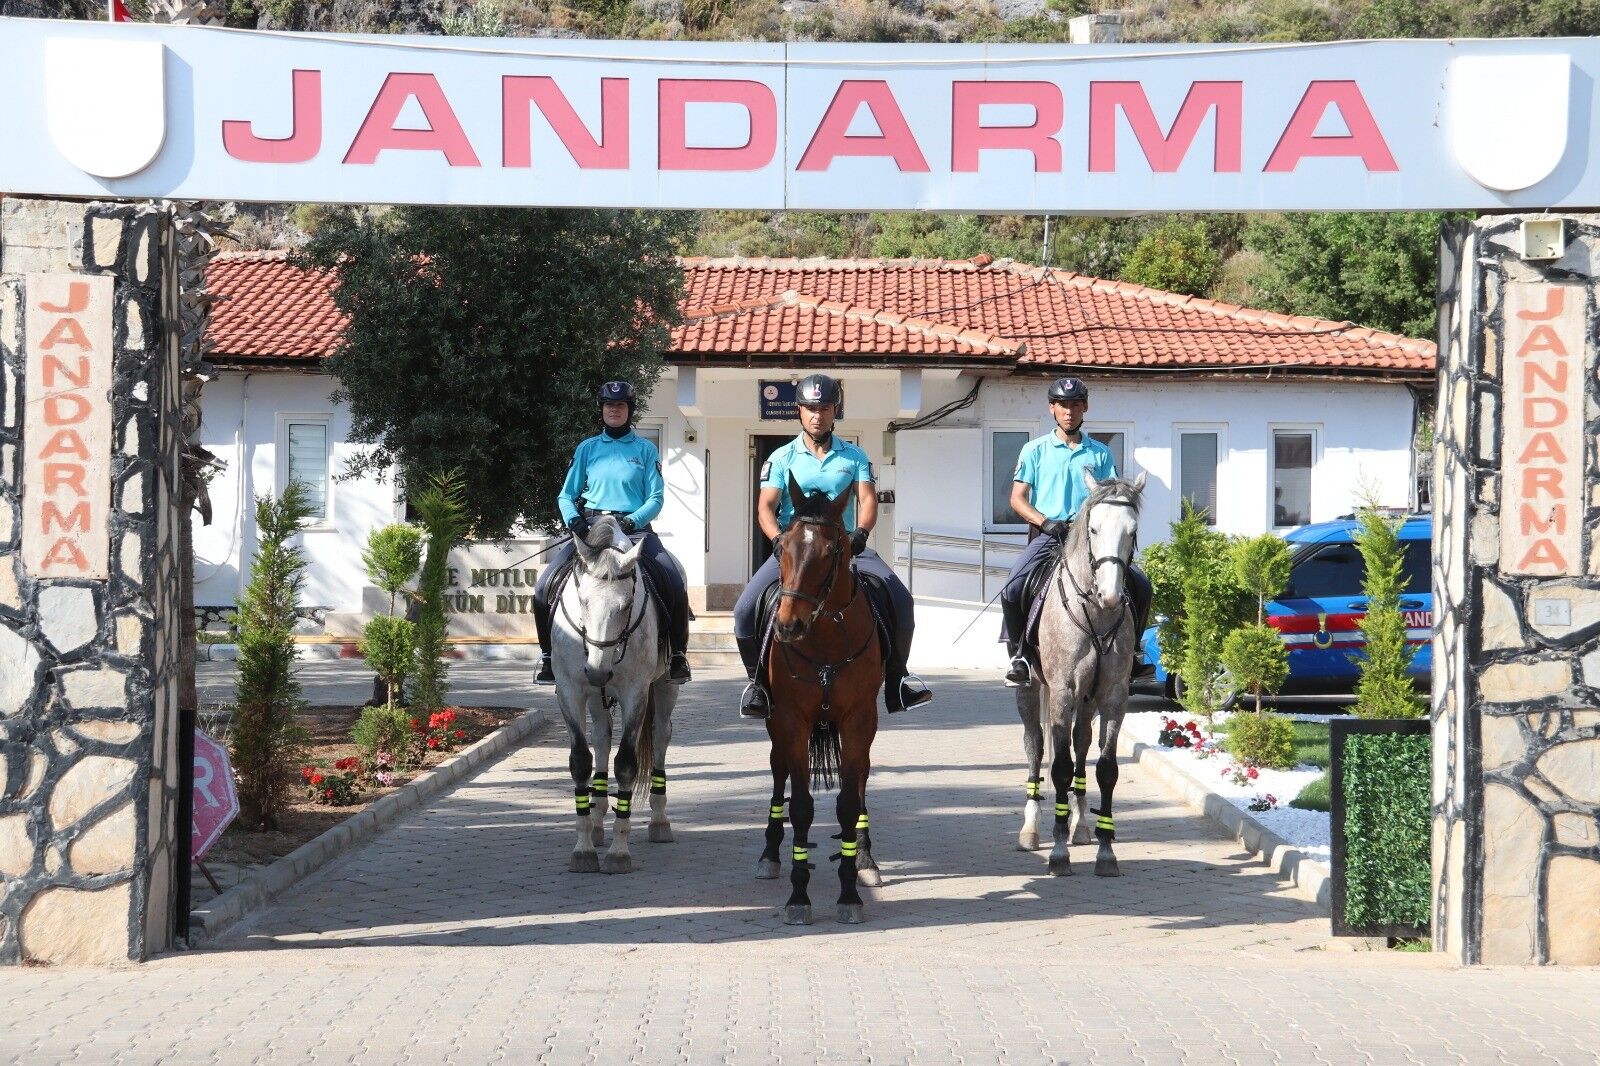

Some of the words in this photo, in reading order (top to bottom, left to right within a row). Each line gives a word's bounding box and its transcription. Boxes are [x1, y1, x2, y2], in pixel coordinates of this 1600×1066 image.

[222, 69, 1400, 173] JANDARMA
[38, 281, 93, 572] JANDARMA
[1515, 286, 1569, 572] JANDARMA
[446, 568, 459, 587] E
[470, 568, 538, 588] MUTLU
